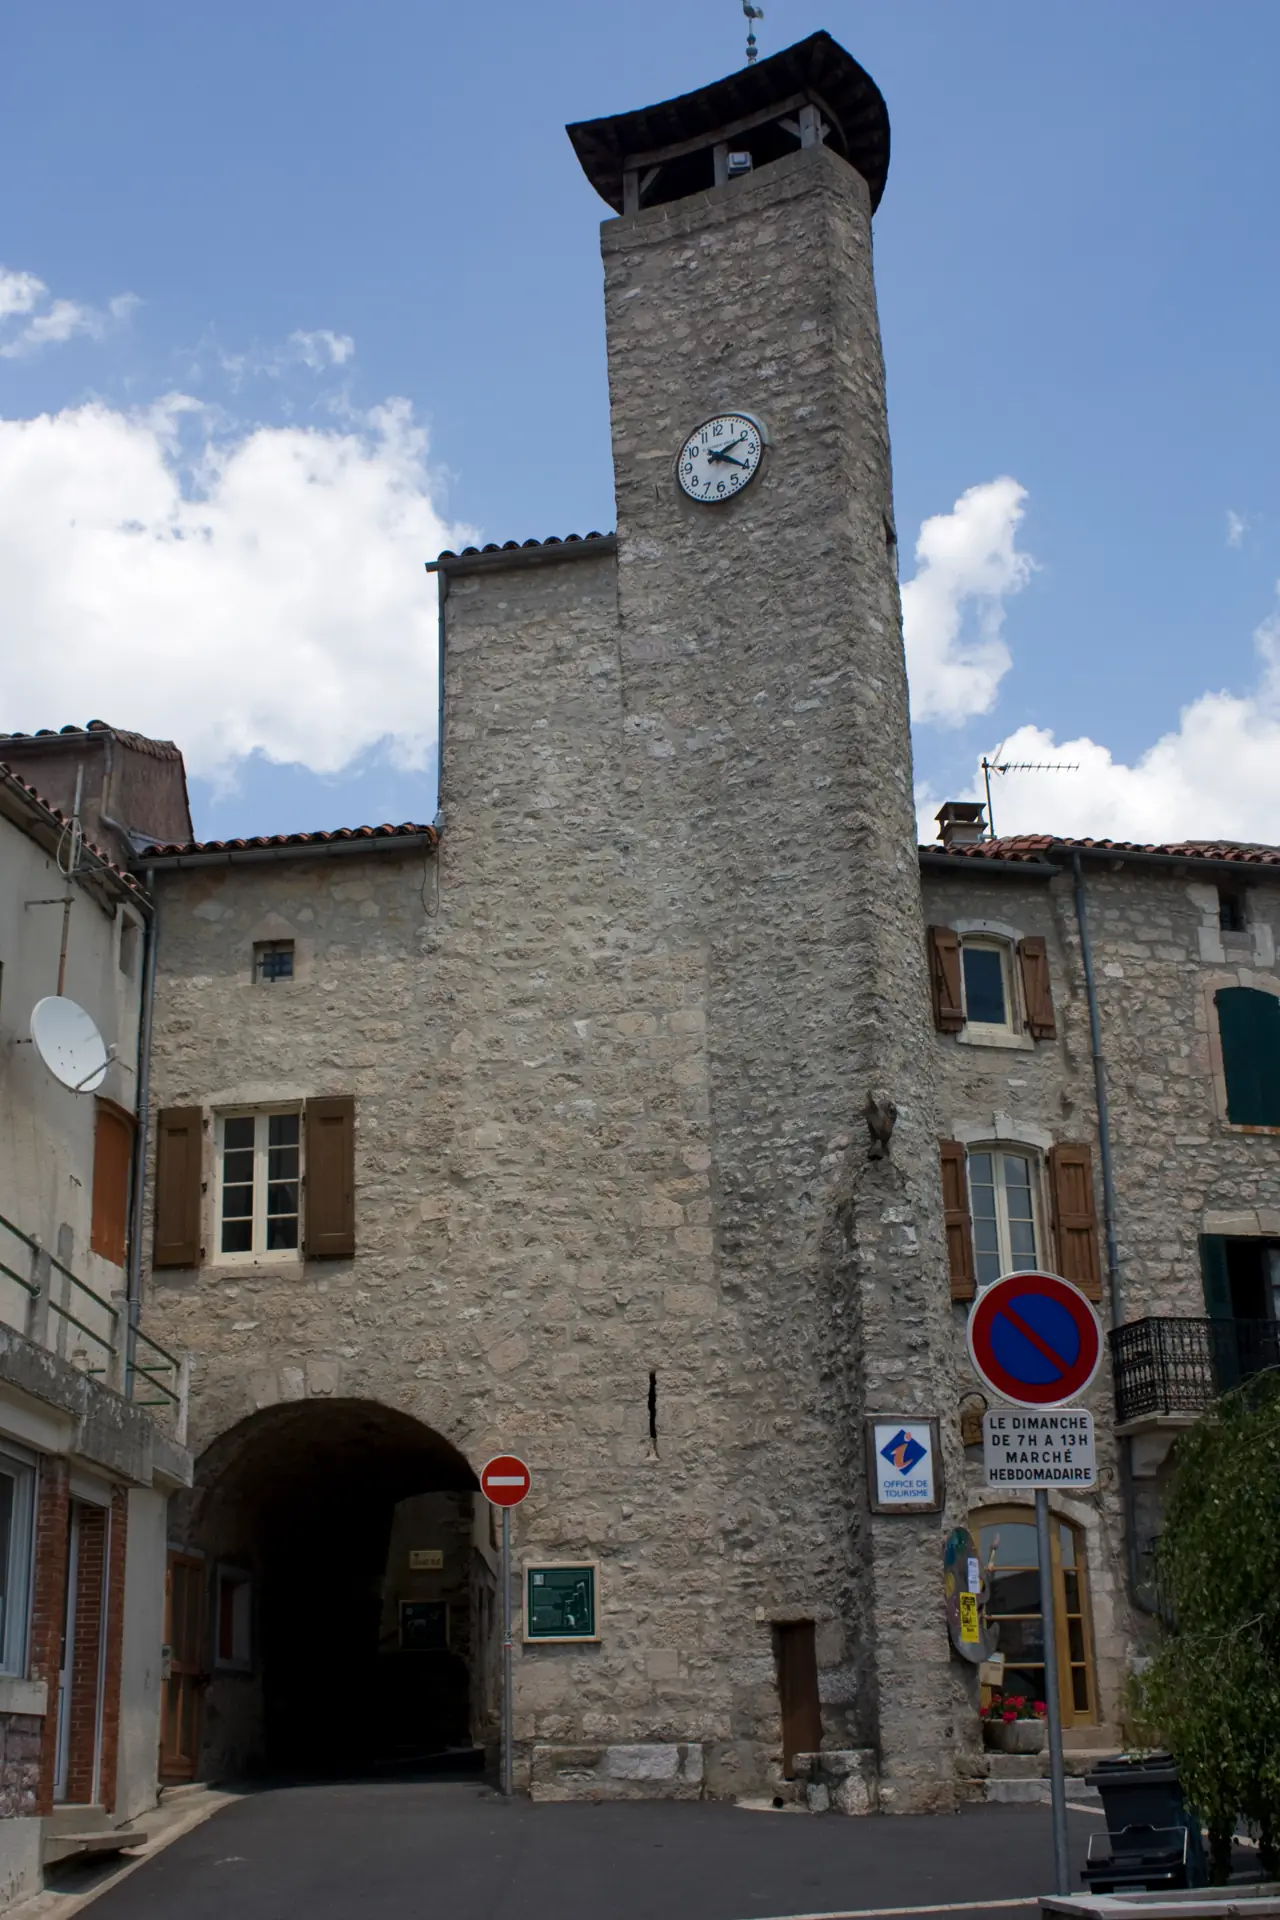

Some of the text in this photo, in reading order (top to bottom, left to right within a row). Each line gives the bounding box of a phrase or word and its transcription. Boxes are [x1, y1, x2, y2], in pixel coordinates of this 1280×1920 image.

[712, 423, 723, 437] 12
[730, 423, 734, 434] 1
[701, 431, 708, 444] 11
[740, 430, 749, 442] 2
[688, 445, 699, 459] 10
[747, 442, 756, 455] 3
[684, 462, 693, 474] 9
[742, 458, 750, 470] 4
[691, 475, 699, 487] 8
[730, 473, 739, 486] 5
[703, 481, 712, 495] 7
[716, 481, 726, 493] 6
[990, 1417, 1088, 1429] LE DIMANCHE
[992, 1434, 1010, 1446] DE
[1045, 1434, 1054, 1446] A
[1006, 1449, 1073, 1463] MARCHÉ
[990, 1468, 1091, 1480] HEBDOMADAIRE
[883, 1480, 928, 1488] OFFICE DE
[884, 1489, 928, 1497] TOURISME
